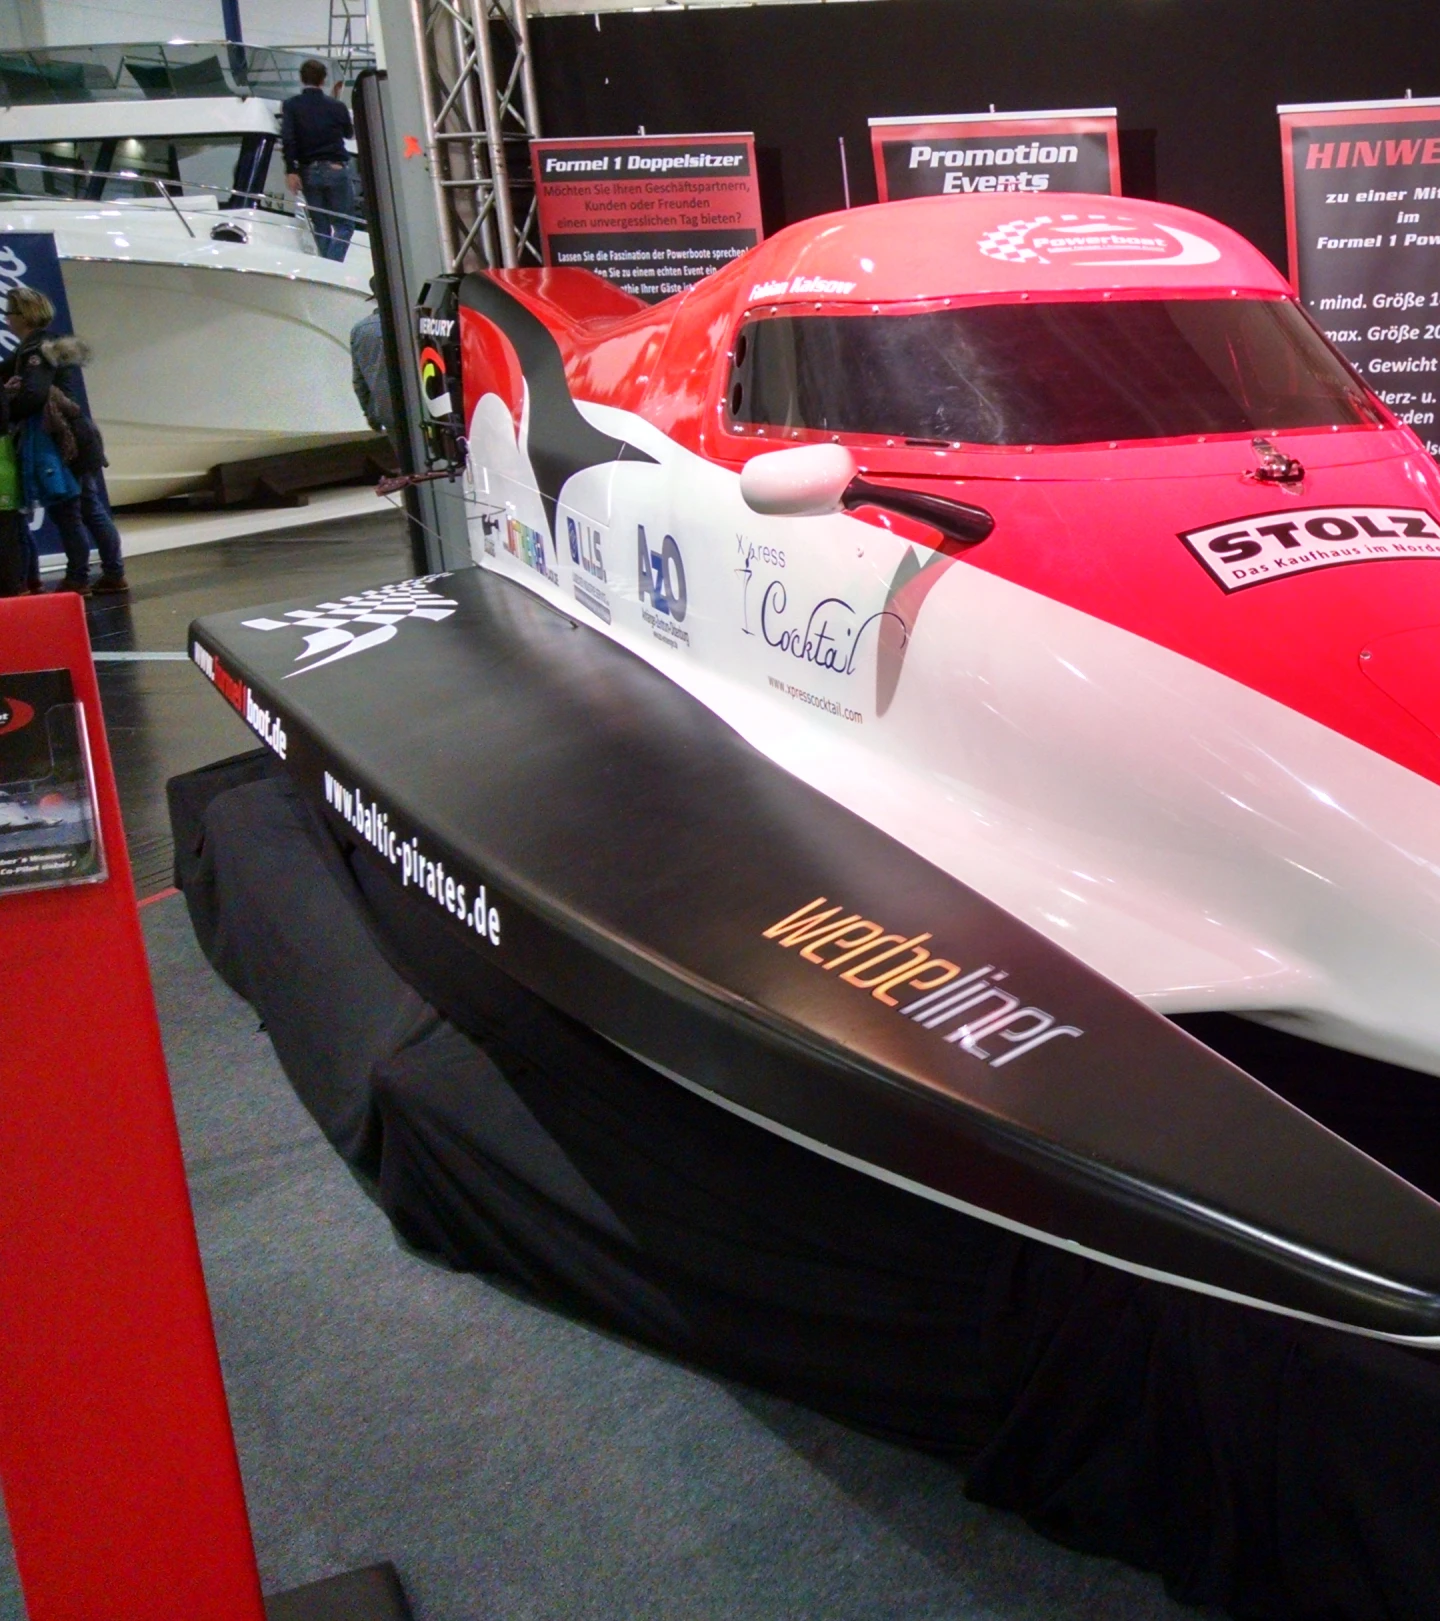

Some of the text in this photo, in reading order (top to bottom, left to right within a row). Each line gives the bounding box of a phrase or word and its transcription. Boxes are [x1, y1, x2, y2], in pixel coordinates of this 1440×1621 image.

[545, 153, 743, 173] Formel 1 Doppelsitzer
[909, 141, 1078, 169] Promotion
[544, 180, 751, 196] Möchten Sie Ihren Geschäftspartnern,
[943, 172, 1050, 193] Events
[584, 197, 710, 212] Kunden oder Freunden
[1325, 193, 1349, 204] zu
[1356, 189, 1407, 202] einer
[557, 211, 742, 229] einen unvergesslichen Tag bieten?
[1396, 211, 1421, 224] im
[1031, 234, 1168, 249] Powerboat
[1316, 233, 1382, 250] Formel
[1388, 234, 1398, 247] 1
[557, 252, 582, 262] Lassen
[583, 251, 595, 262] Sie
[596, 250, 608, 261] die
[609, 249, 651, 261] Faszination
[652, 249, 665, 260] der
[666, 247, 711, 260] Powerboote
[608, 267, 621, 278] Sie
[622, 269, 632, 278] zu
[632, 267, 656, 278] einem
[657, 266, 682, 277] echten
[683, 265, 707, 276] Event
[640, 283, 660, 294] Ihrer
[660, 282, 682, 293] Gäste
[748, 276, 857, 302] Fabian Kalsow
[1320, 294, 1367, 310] mind.
[1372, 292, 1428, 311] Größe
[419, 317, 455, 338] MERCURY
[1367, 324, 1420, 343] Größe
[1368, 356, 1438, 373] Gewicht
[1420, 391, 1436, 404] u.
[1208, 515, 1440, 565] STOLZ
[1231, 563, 1270, 580] Das
[1276, 545, 1361, 569] Kaufhaus
[1366, 542, 1389, 554] im
[637, 523, 687, 623] AzO
[761, 580, 908, 676] Cocktail
[767, 675, 863, 724] www.xpresscocktail.com
[323, 770, 502, 947] www.baltic-pirates.de
[761, 896, 1086, 1069] werbeliner
